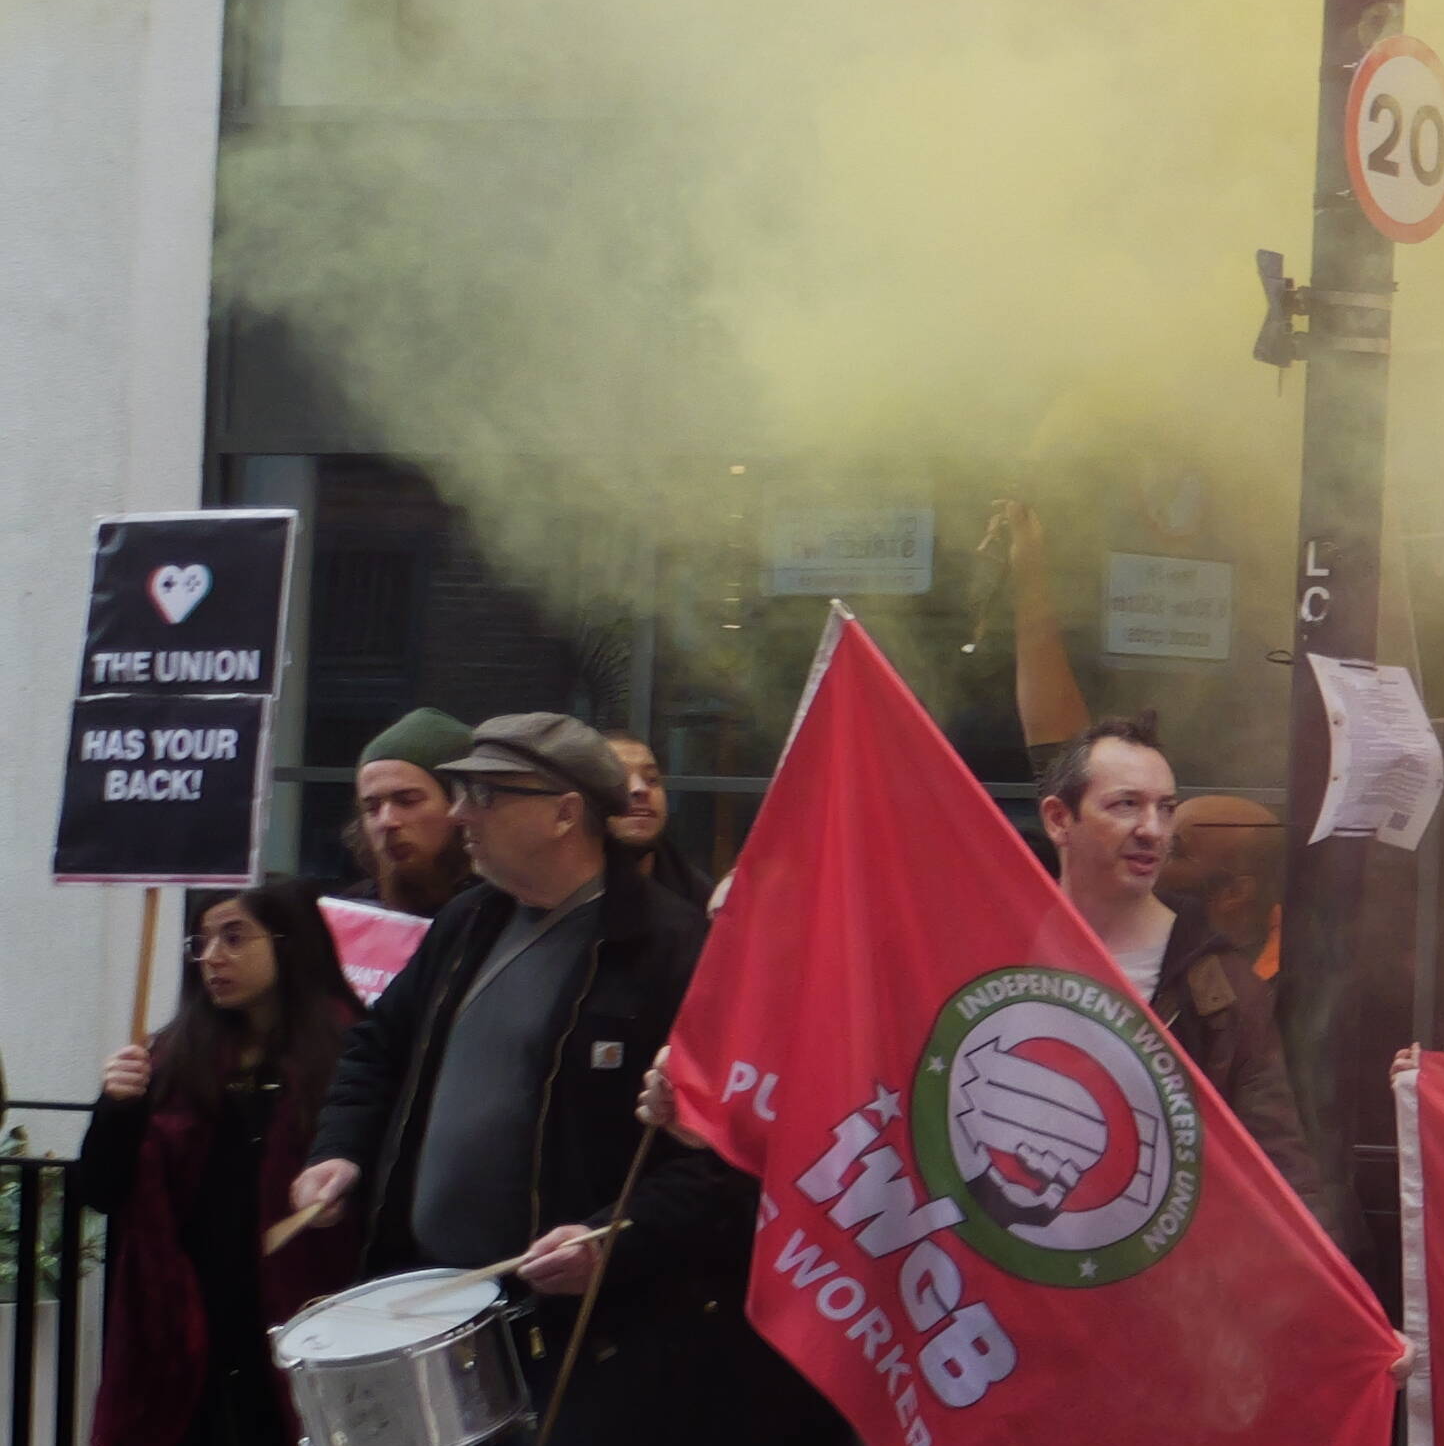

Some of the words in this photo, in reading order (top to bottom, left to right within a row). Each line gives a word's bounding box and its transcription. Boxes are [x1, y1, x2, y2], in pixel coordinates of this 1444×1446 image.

[93, 651, 151, 684] THE
[155, 648, 260, 683] UNION
[82, 730, 144, 762] HAS
[150, 727, 237, 762] YOUR
[104, 767, 203, 803] BACK!
[955, 971, 1133, 1033] INDEPENDENT
[1132, 1021, 1199, 1164] WORKERS
[1144, 1168, 1200, 1255] UNION
